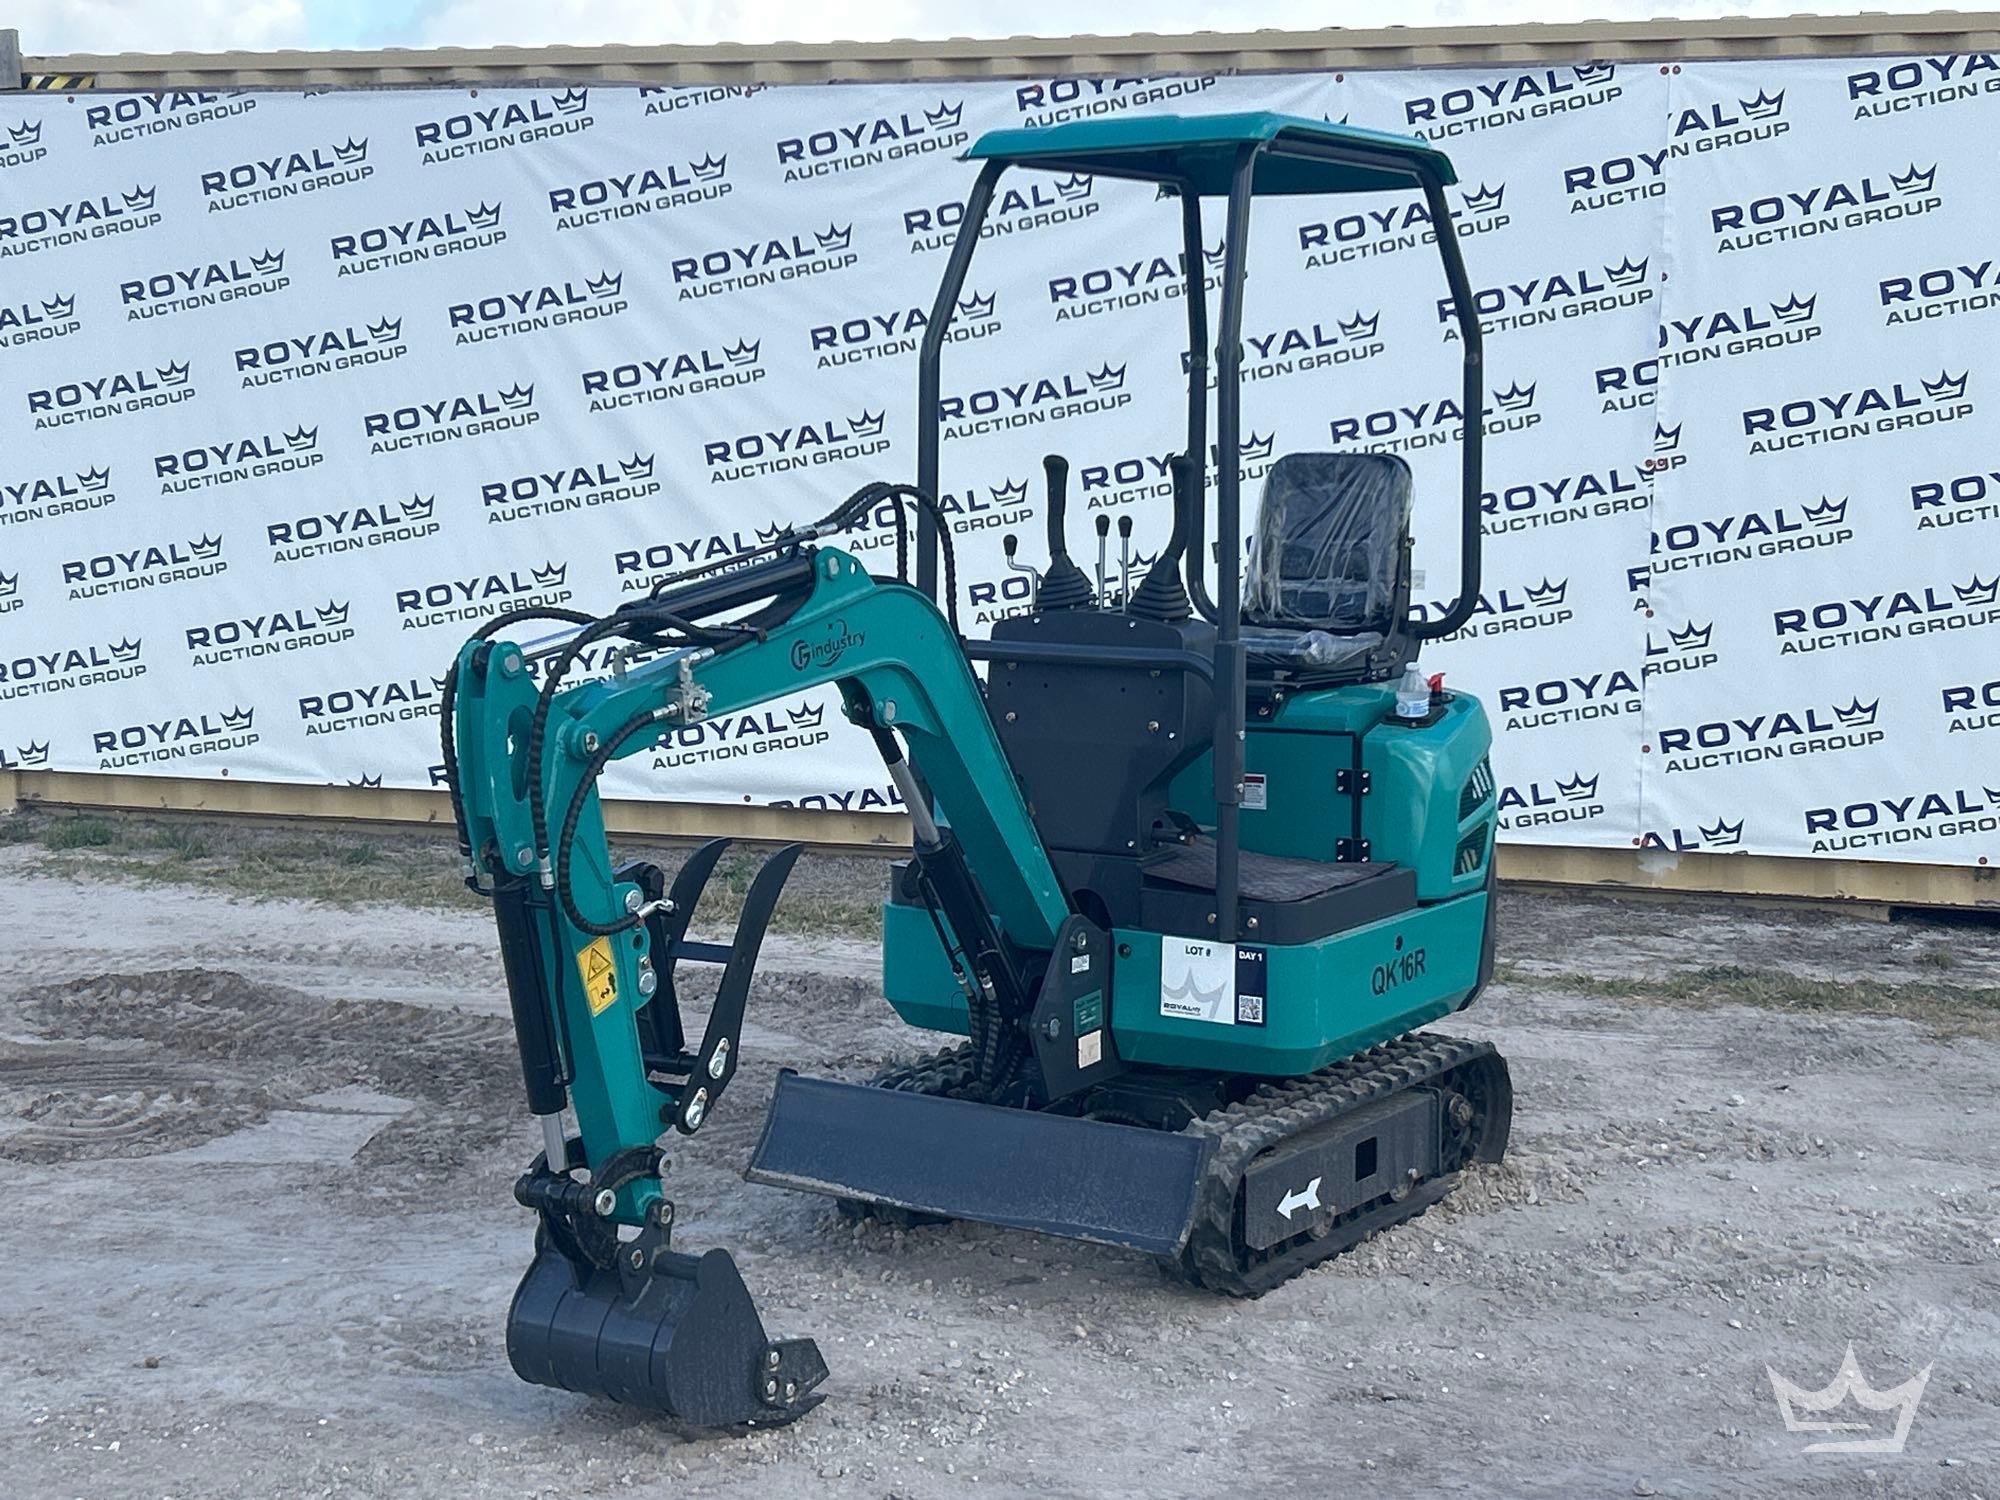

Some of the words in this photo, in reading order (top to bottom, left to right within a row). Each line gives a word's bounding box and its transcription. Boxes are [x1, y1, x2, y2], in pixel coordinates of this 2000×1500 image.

[1405, 70, 1574, 125] ROYAL
[1847, 55, 2000, 101] ROYA
[94, 116, 182, 147] AUCTION
[185, 99, 256, 125] GROUP
[415, 99, 553, 147] ROYAL
[645, 86, 742, 116] AUCTION
[1024, 95, 1127, 128] AUCTION
[1132, 76, 1215, 106] GROUP
[1414, 108, 1525, 142] AUCTION
[1531, 87, 1622, 118] GROUP
[1854, 82, 1978, 120] AUCTION
[422, 134, 515, 166] AUCTION
[519, 117, 594, 143] GROUP
[777, 114, 925, 165] ROYAL
[784, 150, 883, 183] AUCTION
[887, 131, 968, 160] GROUP
[1695, 122, 1790, 152] GROUP
[201, 149, 334, 196] ROYAL
[208, 183, 298, 213] AUCTION
[302, 166, 374, 192] GROUP
[549, 166, 691, 213] ROYAL
[1564, 148, 1669, 194] ROY
[0, 196, 123, 241] ROYAL
[557, 200, 651, 231] AUCTION
[655, 183, 732, 210] GROUP
[1018, 202, 1099, 230] GROUP
[1570, 182, 1666, 214] AUCTIO
[1711, 178, 1890, 234] ROYAL
[1, 229, 88, 258] AUCTION
[91, 213, 161, 238] GROUP
[331, 213, 467, 259] ROYAL
[1305, 234, 1416, 269] AUCTION
[1422, 215, 1510, 245] GOUP
[1718, 217, 1838, 253] AUCTION
[1844, 197, 1942, 228] GROUP
[338, 247, 429, 277] AUCTION
[433, 231, 506, 256] GROUP
[672, 236, 815, 283] ROYAL
[120, 260, 252, 304] ROYAL
[128, 293, 216, 322] AUCTION
[219, 277, 290, 302] GROUP
[679, 270, 775, 301] AUCTION
[780, 254, 857, 280] GROUP
[1049, 253, 1187, 303] ROYA
[1879, 261, 1994, 306] ROY
[448, 283, 587, 328] ROYAL
[456, 316, 548, 346] AUCTION
[552, 301, 628, 326] GROUP
[1056, 288, 1159, 322] AUCTION
[1443, 307, 1557, 343] ACTION
[1562, 289, 1653, 318] GROUP
[12, 321, 81, 345] GROUP
[235, 327, 368, 372] ROYAL
[811, 307, 957, 351] ROYA
[1727, 326, 1822, 355] GROUP
[242, 361, 331, 389] AUCTION
[335, 345, 407, 370] GROUP
[582, 350, 724, 395] ROYAL
[817, 338, 916, 369] AUCTION
[1298, 343, 1384, 370] GROUP
[28, 371, 158, 413] ROYAL
[35, 403, 122, 430] AUCTION
[126, 388, 195, 412] GROUP
[589, 384, 684, 413] AUCTION
[689, 368, 765, 393] GROUP
[939, 375, 1088, 422] ROYAL
[1743, 384, 1922, 436] ROYAL
[364, 393, 500, 437] ROYAL
[371, 426, 462, 455] AUCTION
[466, 412, 539, 436] GROUP
[944, 410, 1045, 441] AUCTION
[1050, 393, 1131, 420] GROUP
[1749, 422, 1870, 455] AUCTION
[1876, 404, 1973, 432] GROUP
[154, 435, 285, 478] ROYAL
[704, 421, 848, 466] ROYAL
[711, 455, 808, 484] AUCTION
[812, 440, 890, 465] GROUP
[0, 476, 78, 507] YAL
[161, 468, 248, 495] AUCTION
[252, 454, 323, 477] GROUP
[481, 463, 620, 507] ROYAL
[1087, 483, 1172, 510] AUCTIO
[47, 494, 115, 516] GROUP
[267, 504, 401, 546] ROYAL
[488, 496, 581, 524] AUCTION
[586, 482, 660, 506] GROUP
[953, 509, 1033, 534] GROUP
[62, 544, 190, 584] ROYAL
[274, 536, 364, 563] AUCTION
[368, 523, 440, 546] GROUP
[615, 532, 756, 574] ROYAL
[1652, 546, 1752, 574] UCTION
[1758, 529, 1853, 556] GROUP
[69, 575, 154, 601] AUCTION
[159, 562, 227, 584] GROUP
[396, 572, 533, 613] ROYAL
[185, 610, 317, 650] ROYAL
[402, 604, 495, 630] AUCTION
[500, 590, 573, 613] GROUP
[1483, 610, 1573, 635] GROUP
[1774, 588, 1953, 636] ROYAL
[1780, 625, 1901, 655] AUCTION
[1907, 609, 2000, 635] GROUP
[193, 641, 280, 667] AUCTION
[284, 628, 355, 650] GROUP
[1647, 654, 1718, 676] ROUP
[0, 677, 75, 699] UCTION
[79, 665, 147, 686] GROUP
[299, 679, 432, 719] ROYAL
[1499, 669, 1640, 712] ROYA
[93, 715, 222, 754] ROYAL
[306, 711, 395, 736] AUCTION
[401, 703, 442, 721] GRO
[1506, 702, 1619, 731] AUCTION
[1658, 709, 1834, 754] ROYAL
[99, 746, 186, 770] AUCTION
[189, 734, 259, 755] GROUP
[652, 744, 748, 770] AUCTION
[753, 731, 829, 754] GROUP
[1665, 744, 1783, 774] AUCTION
[1789, 730, 1884, 755] GROUP
[1515, 805, 1604, 828] GROUP
[1805, 790, 1984, 834] ROYAL
[1812, 826, 1932, 853] AUCTION
[1938, 817, 2000, 836] GRO
[1185, 945, 1204, 957] LOT
[1239, 950, 1257, 961] DAY
[1258, 953, 1263, 961] 1
